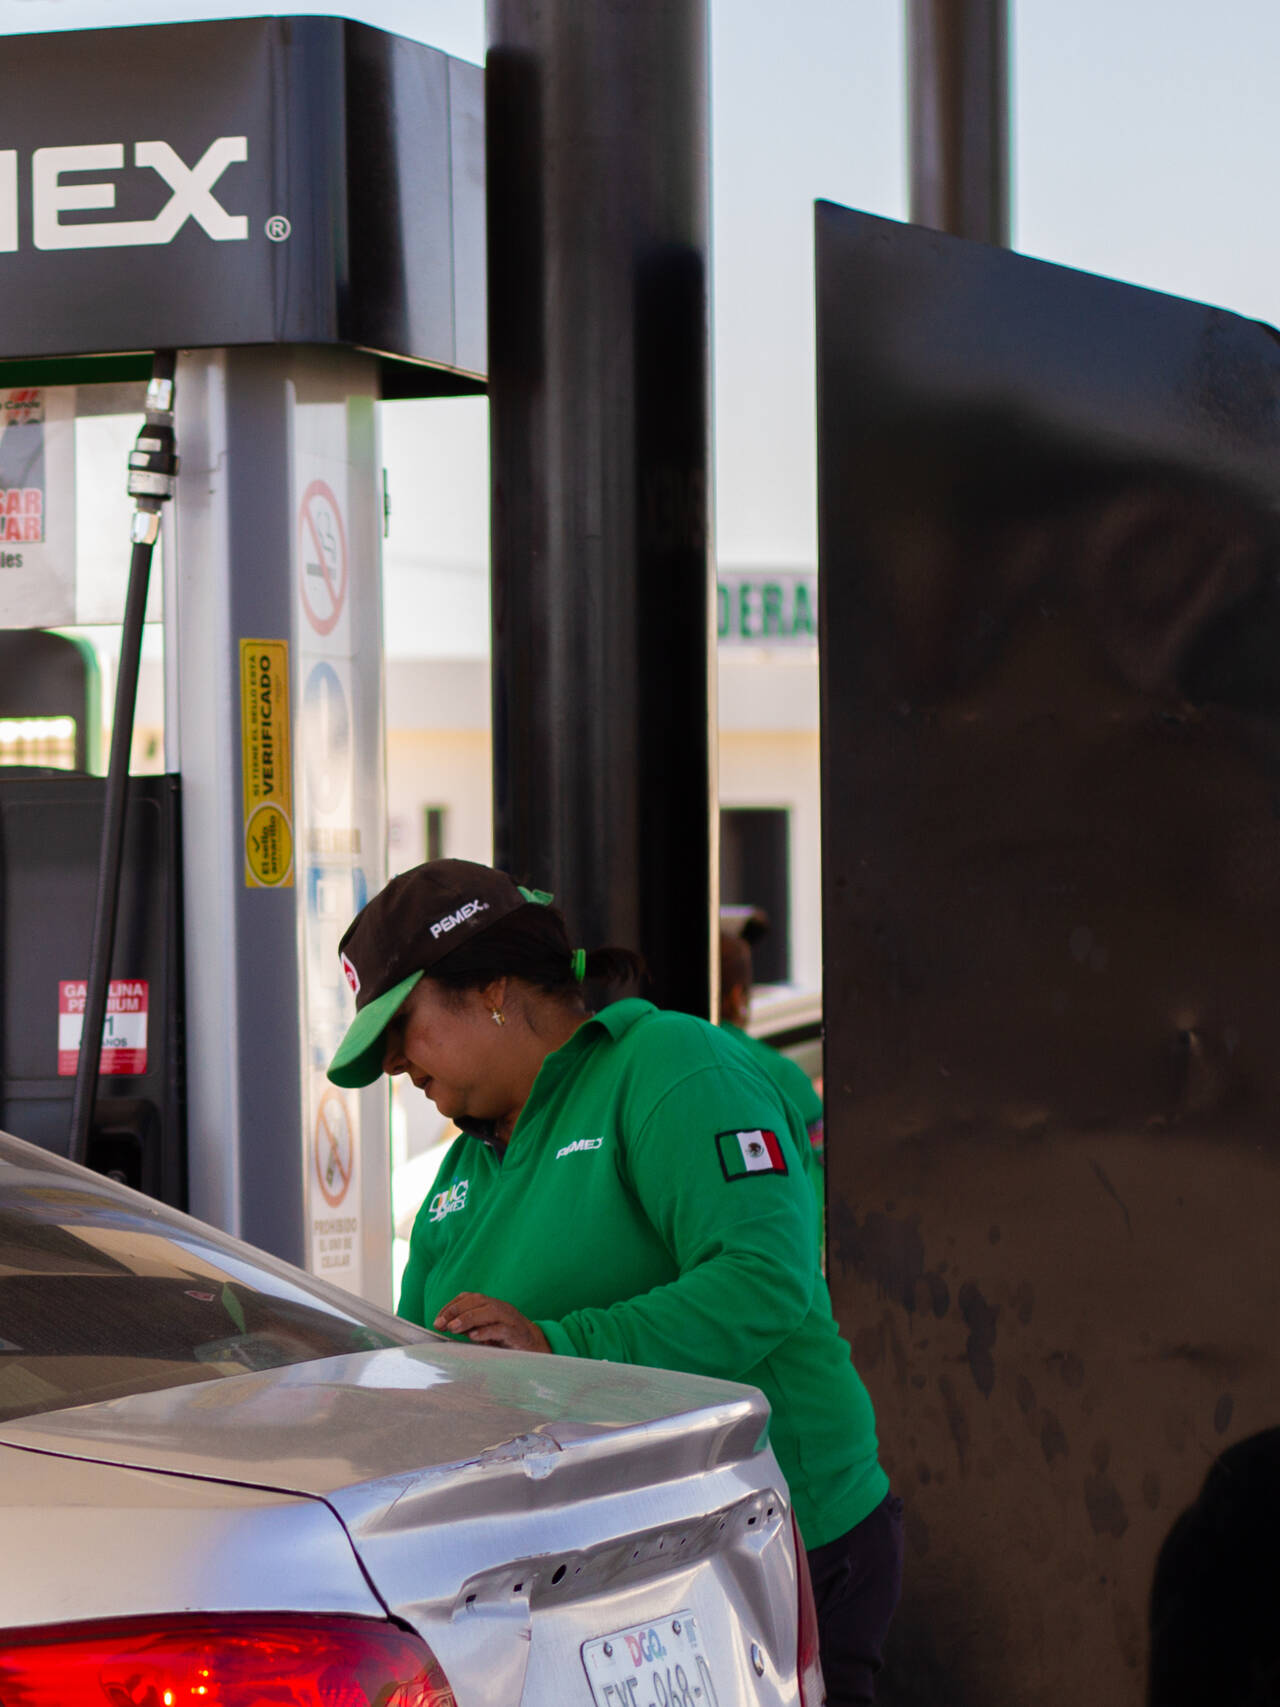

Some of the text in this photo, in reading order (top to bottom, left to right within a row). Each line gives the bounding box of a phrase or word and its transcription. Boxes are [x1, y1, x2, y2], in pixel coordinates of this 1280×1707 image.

[259, 655, 274, 796] VERIFICADO
[261, 862, 270, 875] El
[430, 899, 483, 938] PEMEX
[64, 983, 143, 997] GALINA
[67, 998, 139, 1012] PRIUM
